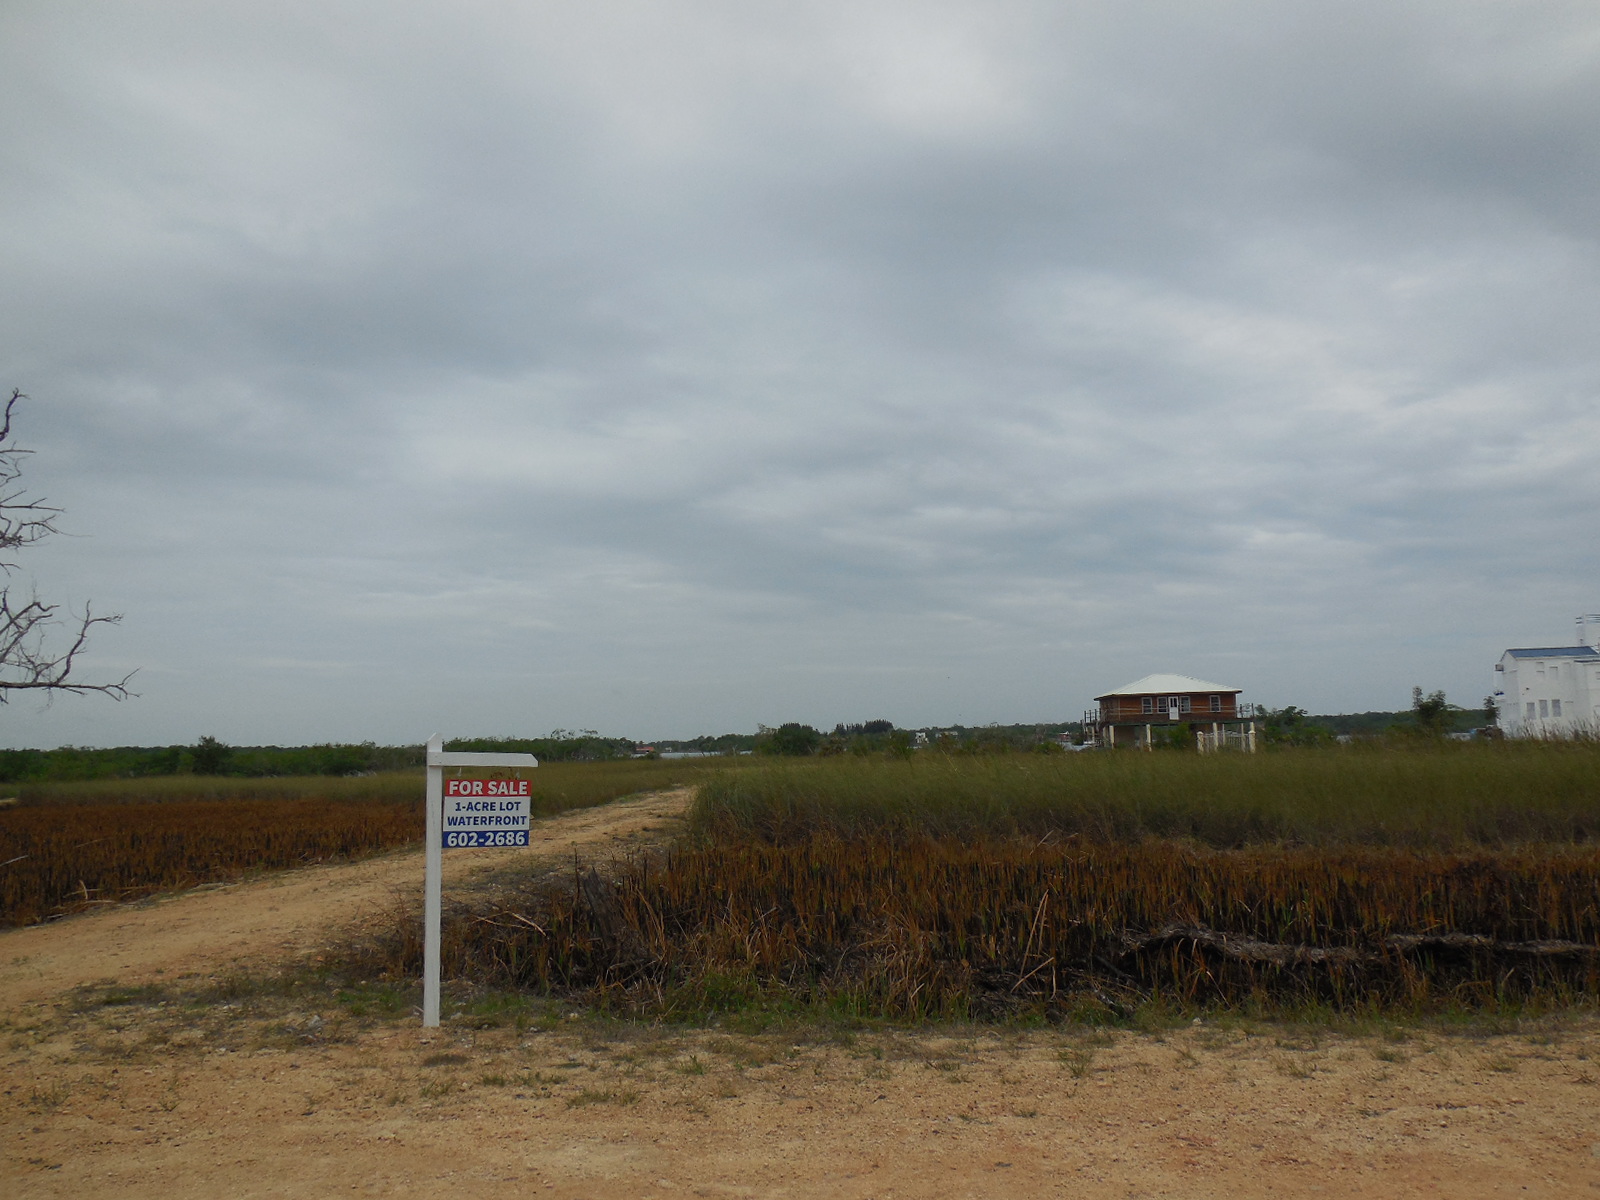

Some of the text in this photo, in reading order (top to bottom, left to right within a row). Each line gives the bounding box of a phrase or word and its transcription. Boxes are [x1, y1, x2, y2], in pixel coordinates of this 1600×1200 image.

[449, 781, 527, 795] FOR SALE
[455, 801, 521, 811] 1-ACRE LOT
[447, 816, 527, 826] WATERFRONT
[447, 832, 525, 847] 602-2686
